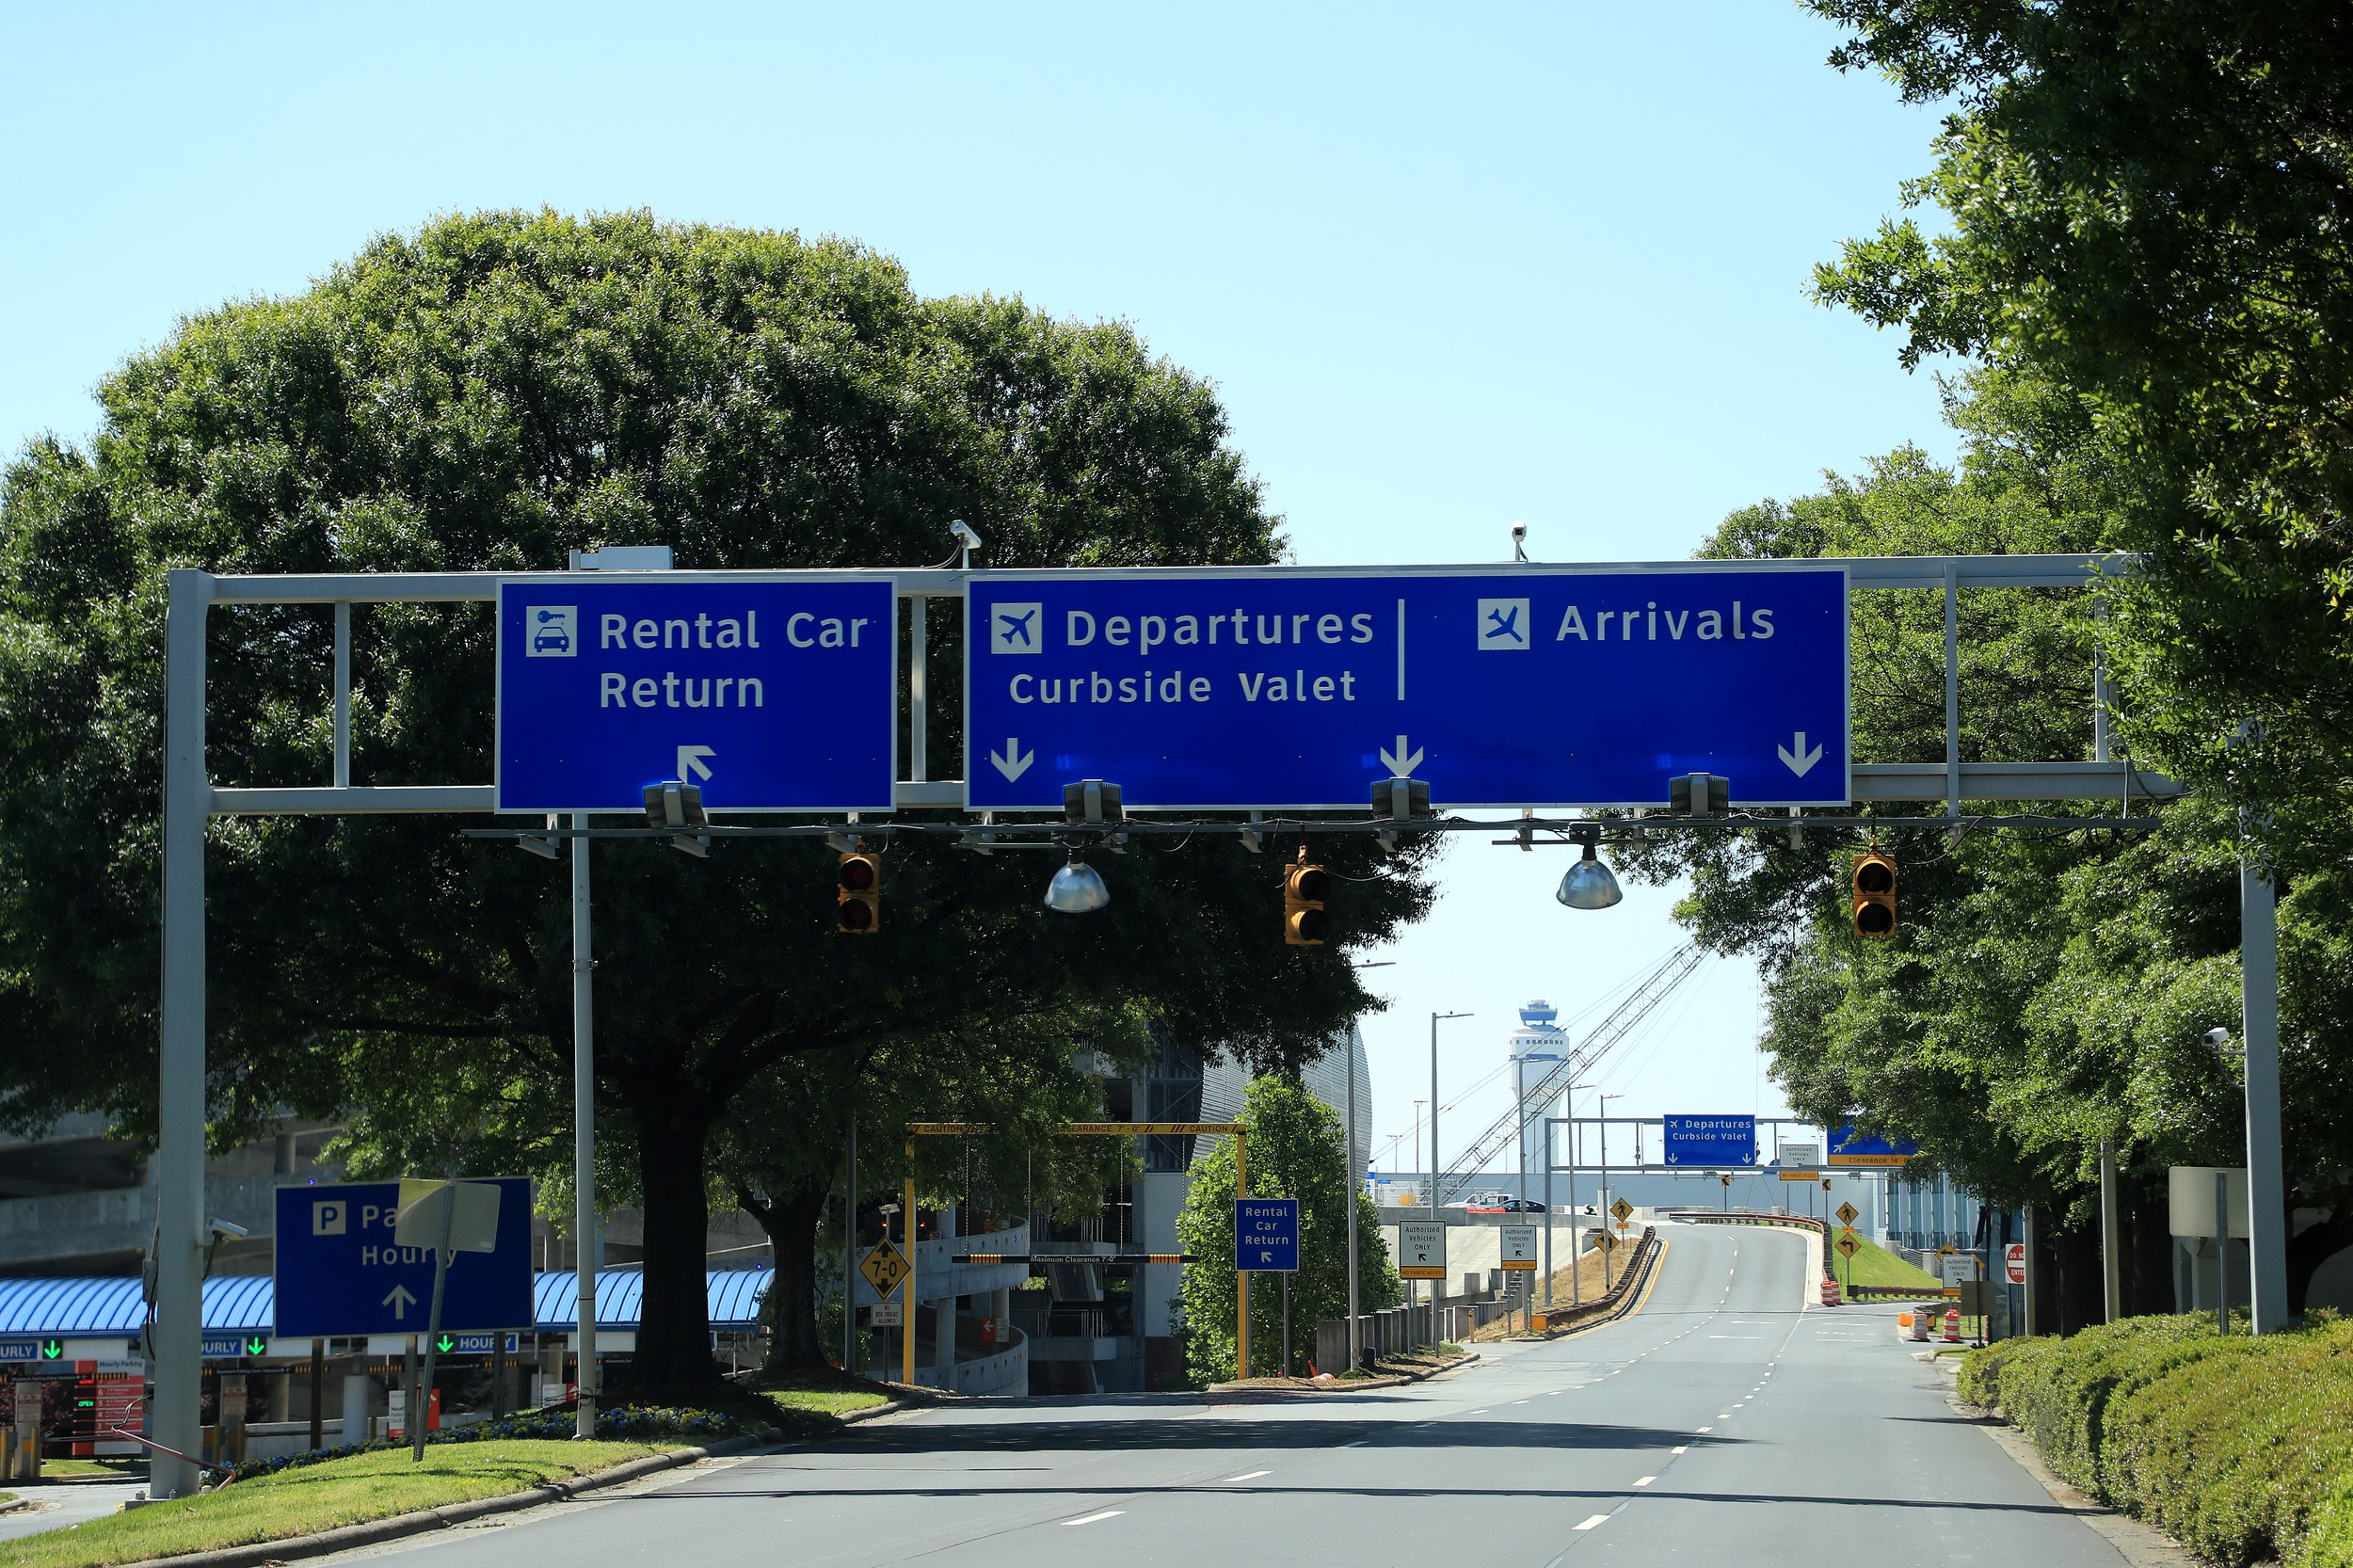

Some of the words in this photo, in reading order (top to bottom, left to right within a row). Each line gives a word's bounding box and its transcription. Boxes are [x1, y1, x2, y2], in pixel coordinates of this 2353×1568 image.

[1556, 600, 1775, 641] Arrivals
[600, 610, 760, 649] Rental
[786, 612, 869, 648] Car
[1066, 608, 1374, 656] Departures
[600, 671, 764, 708] Return
[1010, 670, 1212, 704] Curbside
[1238, 669, 1356, 702] Valet
[1685, 1120, 1752, 1130] Departures
[1673, 1132, 1717, 1141] Curbside
[1721, 1132, 1747, 1141] Valet
[320, 1206, 339, 1231] P
[1245, 1207, 1288, 1217] Rental
[1256, 1221, 1278, 1231] Car
[1245, 1235, 1289, 1245] Return
[201, 1341, 237, 1353] URLY
[460, 1336, 512, 1350] HOURY
